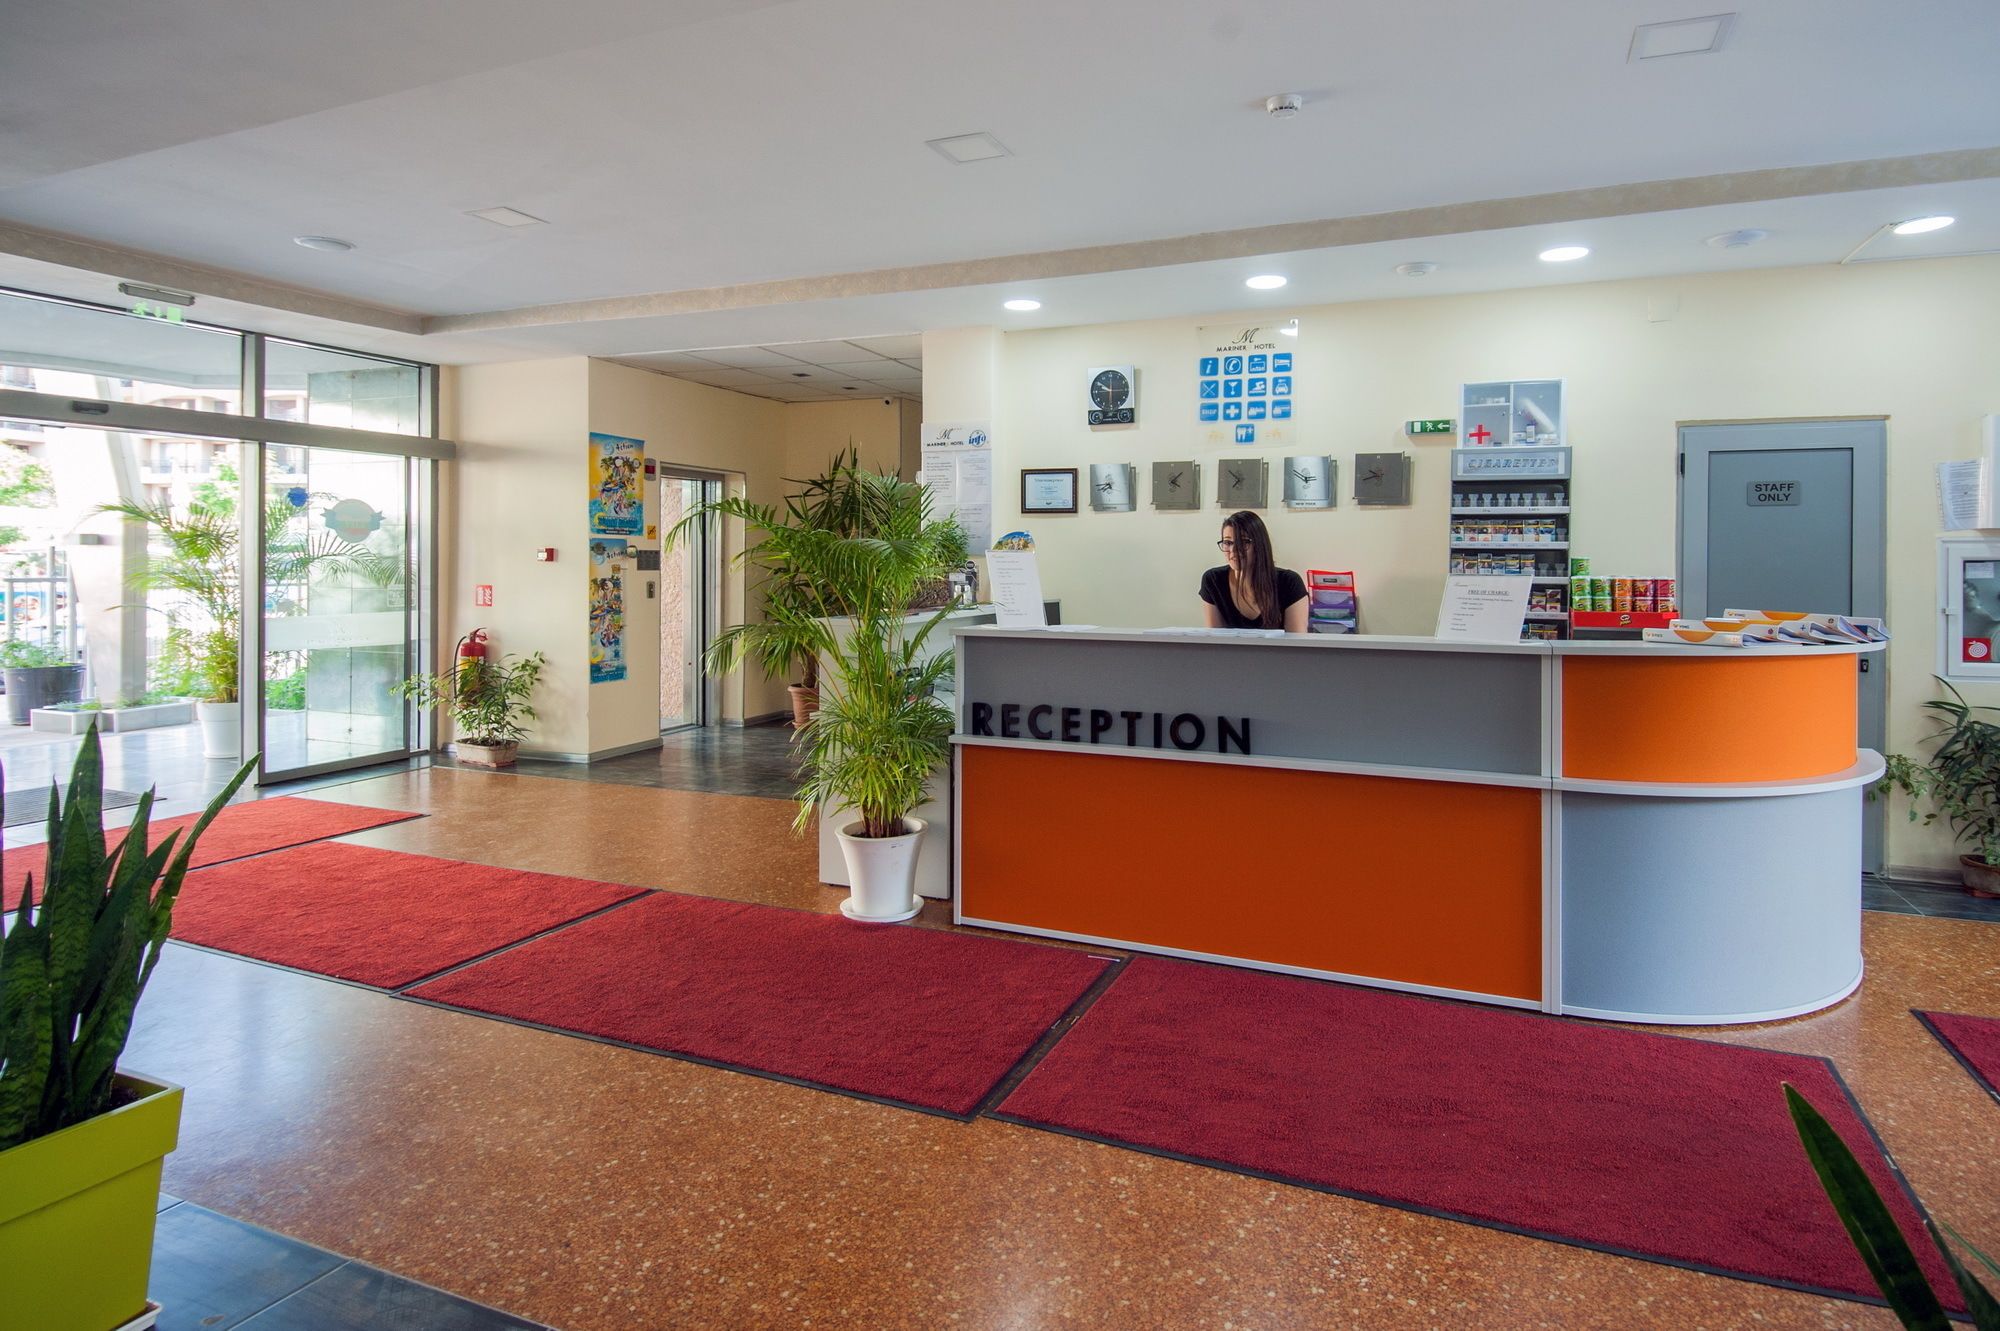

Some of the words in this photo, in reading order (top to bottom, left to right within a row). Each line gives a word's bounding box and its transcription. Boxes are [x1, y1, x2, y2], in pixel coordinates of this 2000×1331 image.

[968, 434, 987, 445] info
[616, 443, 634, 451] Action
[1754, 483, 1795, 492] STAFF
[1758, 493, 1791, 502] ONLY
[971, 702, 1250, 755] RECEPTION
